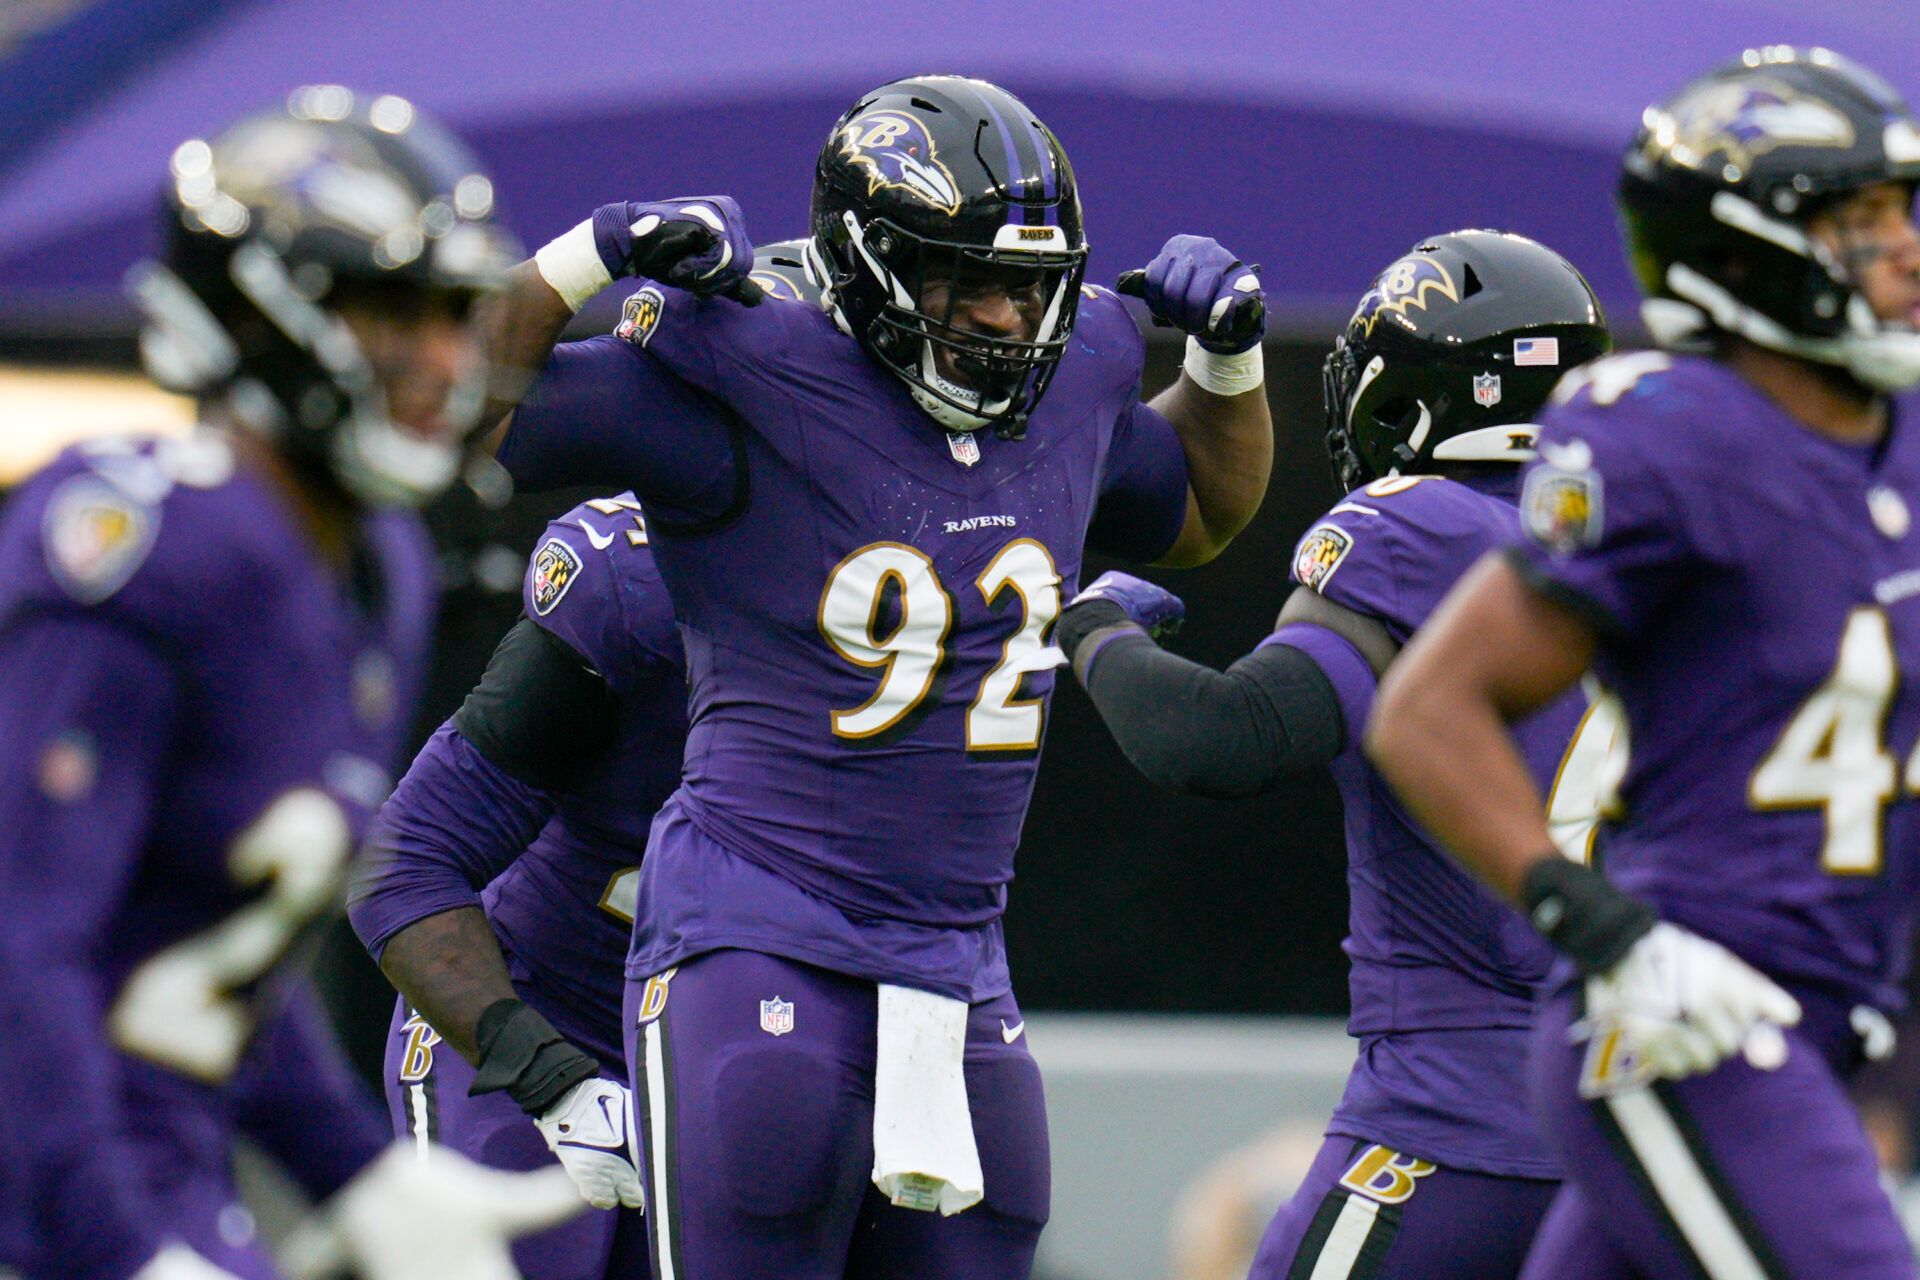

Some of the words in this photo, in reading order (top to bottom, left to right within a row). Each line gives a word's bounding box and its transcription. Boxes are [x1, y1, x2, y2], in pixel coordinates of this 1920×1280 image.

[1018, 228, 1055, 241] RAVENS
[1388, 262, 1417, 294] B
[1478, 388, 1498, 402] NFL
[1505, 433, 1537, 450] R
[955, 444, 976, 458] NFL
[943, 515, 1017, 533] RAVENS
[817, 537, 1064, 753] 92
[1748, 605, 1920, 876] 4
[765, 1013, 790, 1029] NFL
[399, 1014, 442, 1082] B
[1339, 1144, 1438, 1206] B
